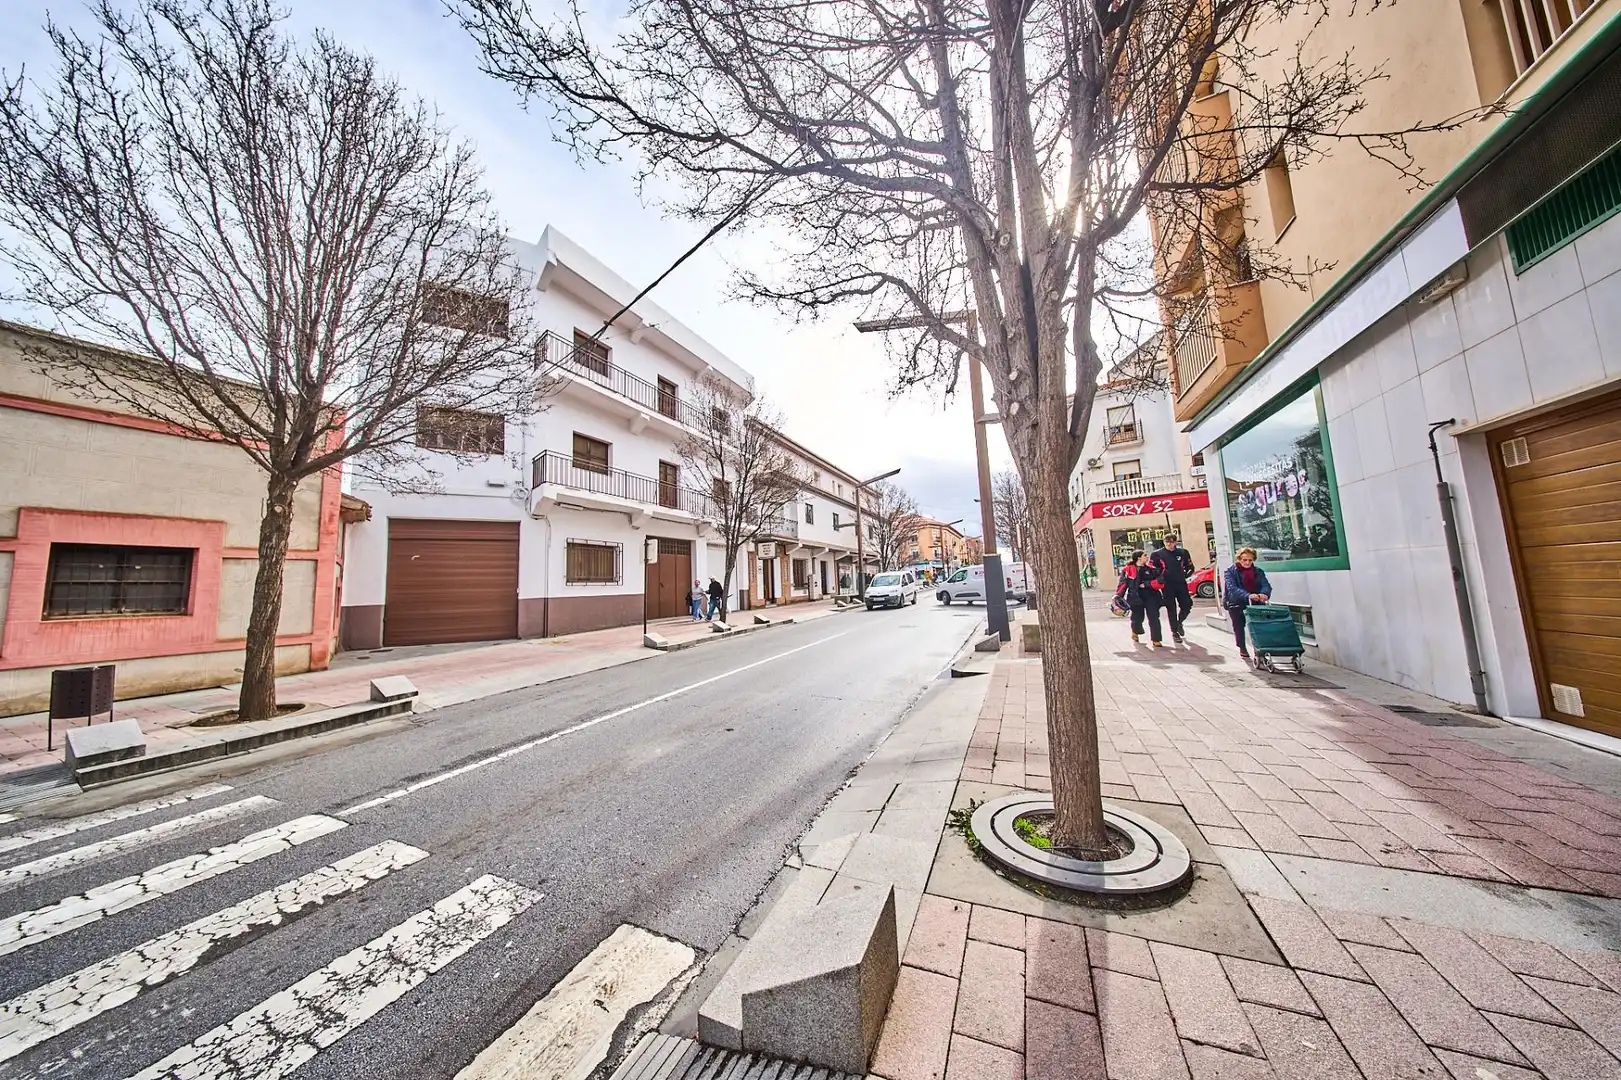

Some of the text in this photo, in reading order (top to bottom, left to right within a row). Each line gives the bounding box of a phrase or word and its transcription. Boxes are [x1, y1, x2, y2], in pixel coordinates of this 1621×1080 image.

[1102, 500, 1174, 518] SORY 32
[1128, 533, 1136, 541] 12
[1156, 531, 1164, 539] 12
